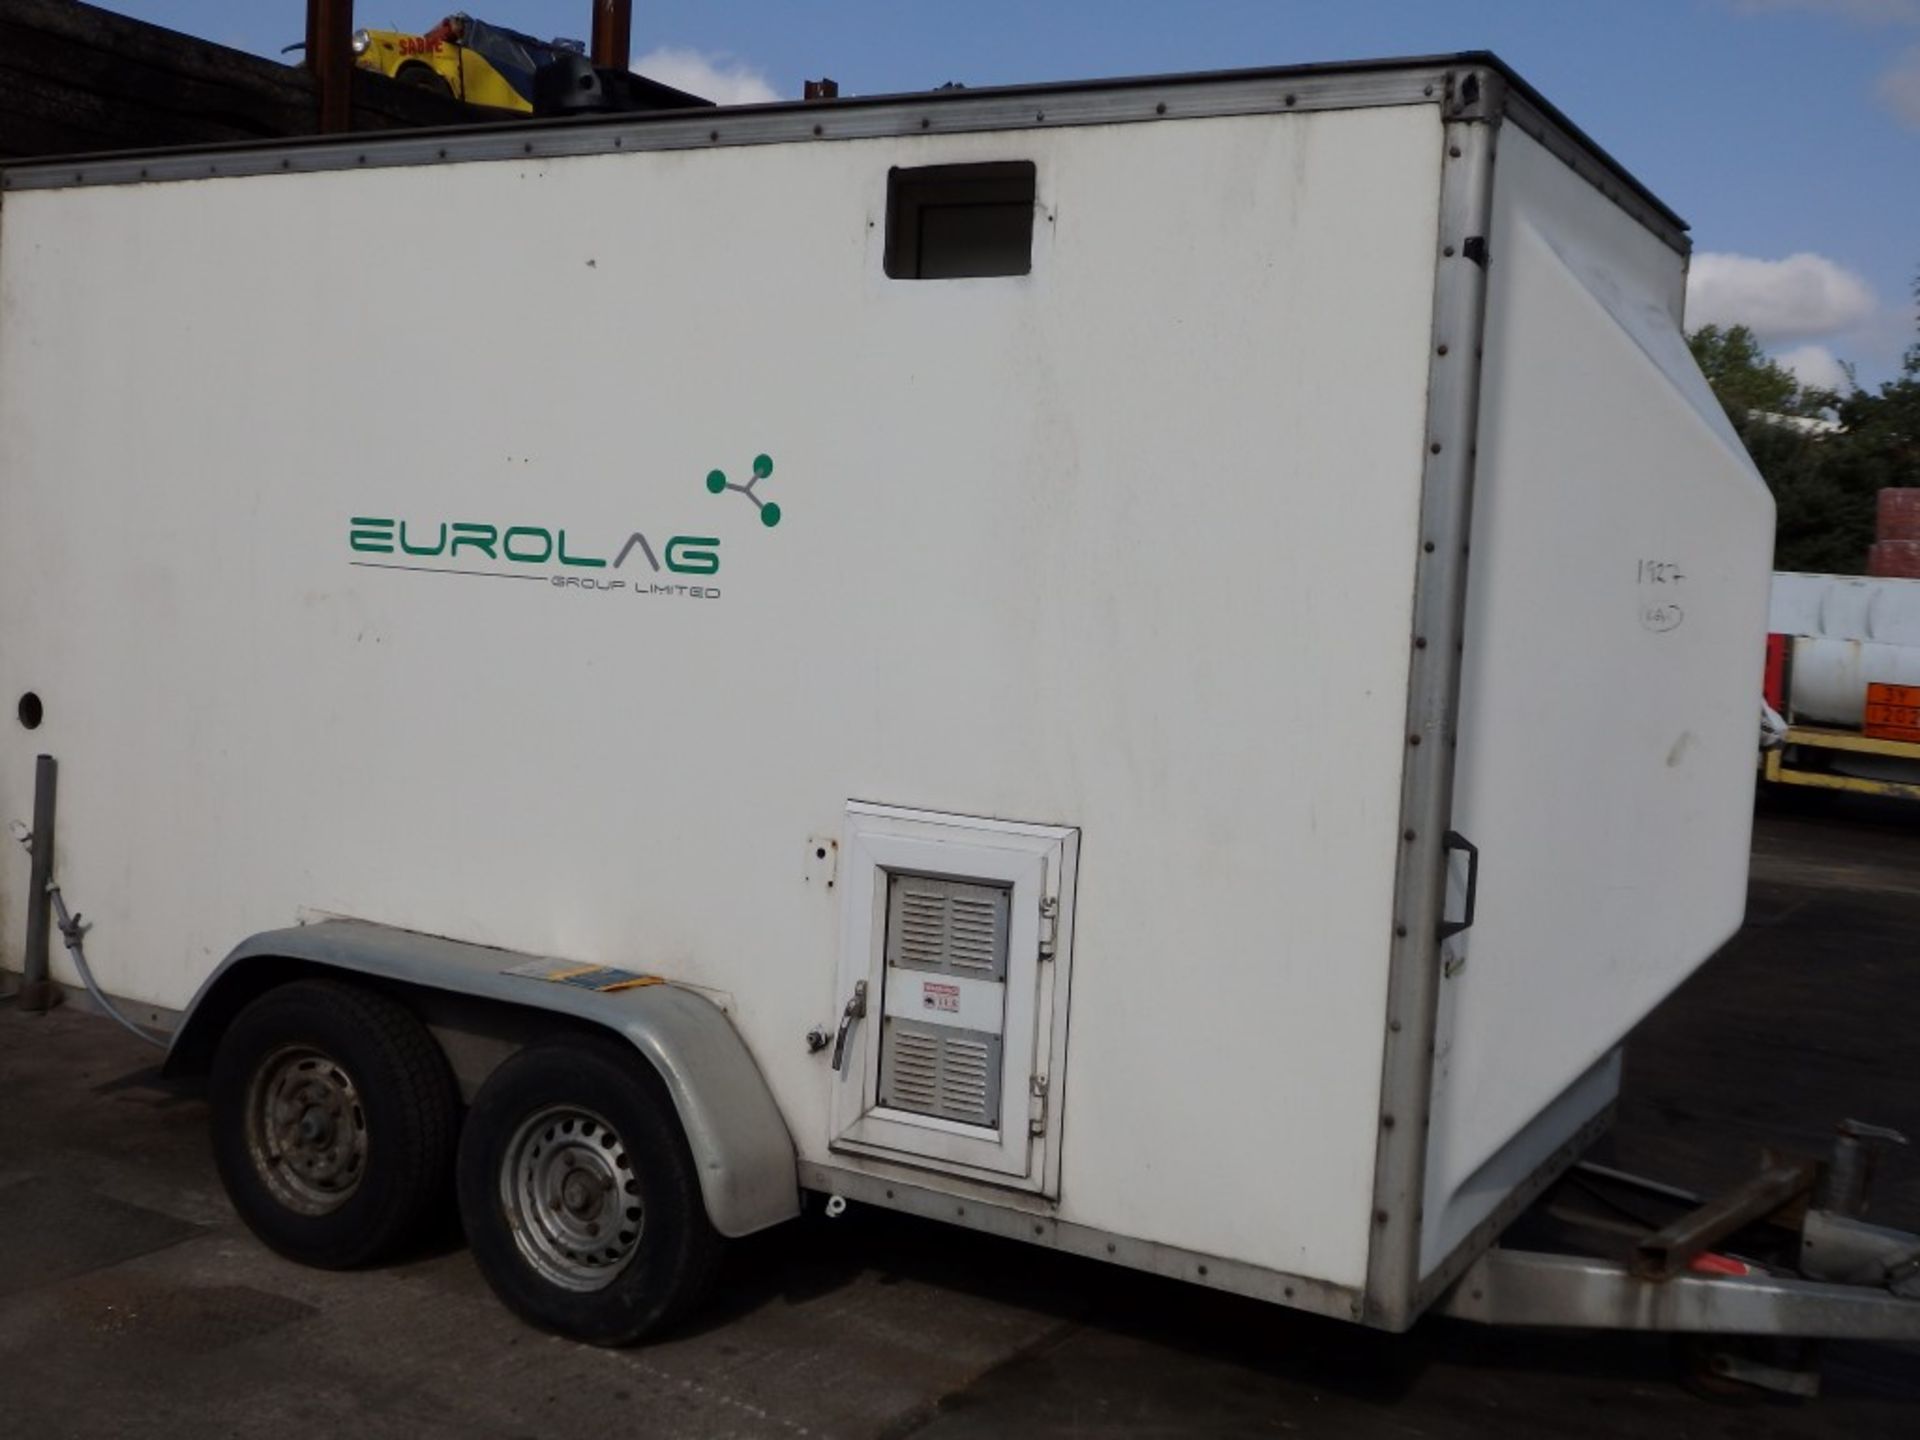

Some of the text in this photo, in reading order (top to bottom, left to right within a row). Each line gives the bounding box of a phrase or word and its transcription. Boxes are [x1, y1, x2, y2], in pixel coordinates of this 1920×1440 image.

[350, 516, 721, 575] EUROLAG
[551, 576, 721, 599] GROUP LIMITED
